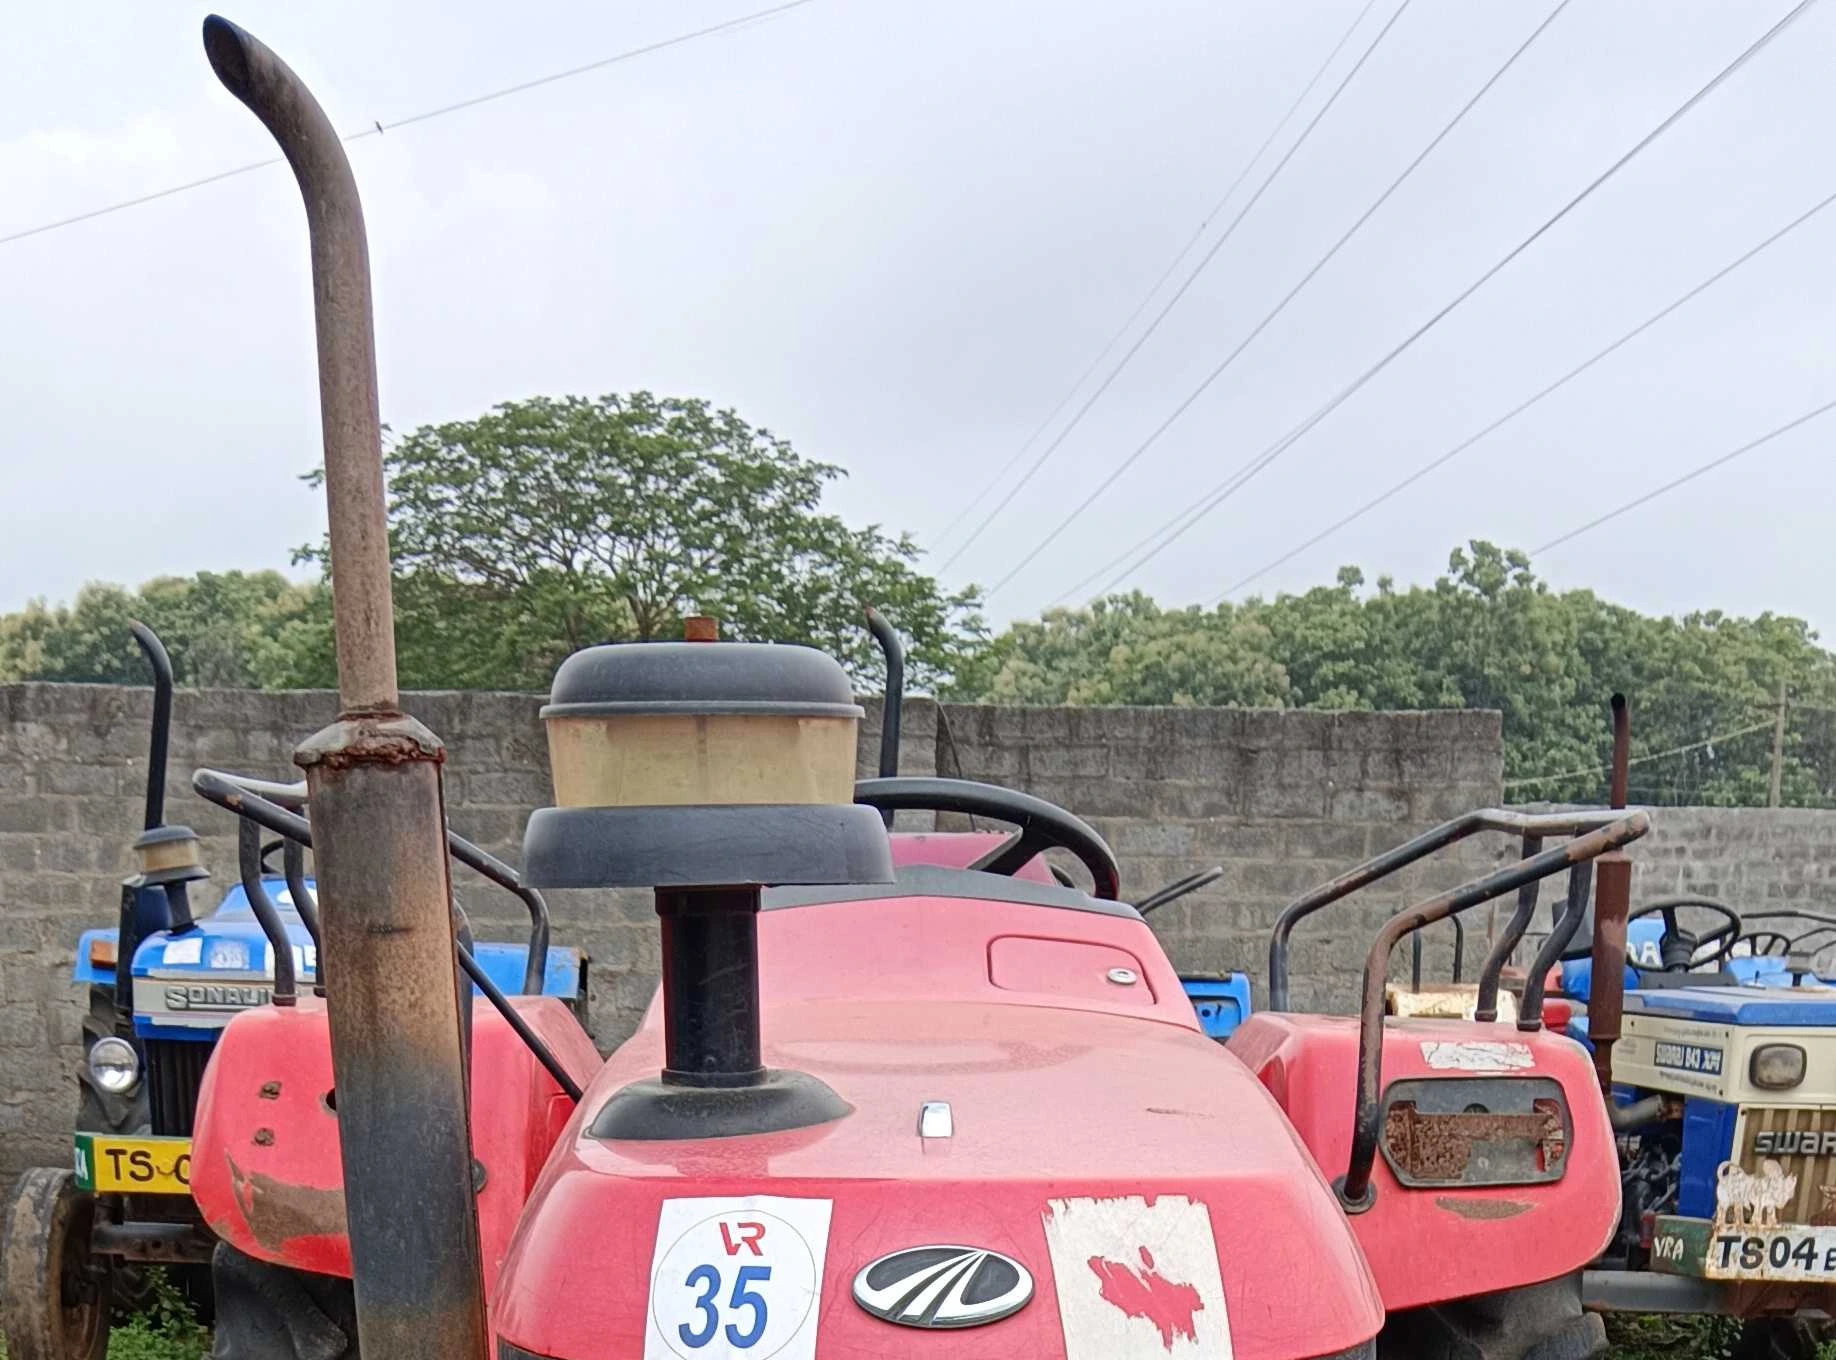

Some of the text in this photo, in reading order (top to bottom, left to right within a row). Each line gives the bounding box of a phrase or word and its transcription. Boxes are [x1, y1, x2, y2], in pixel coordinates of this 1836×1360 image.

[165, 986, 273, 1010] SONALI
[1654, 1236, 1684, 1261] VRA
[678, 1264, 772, 1349] 35
